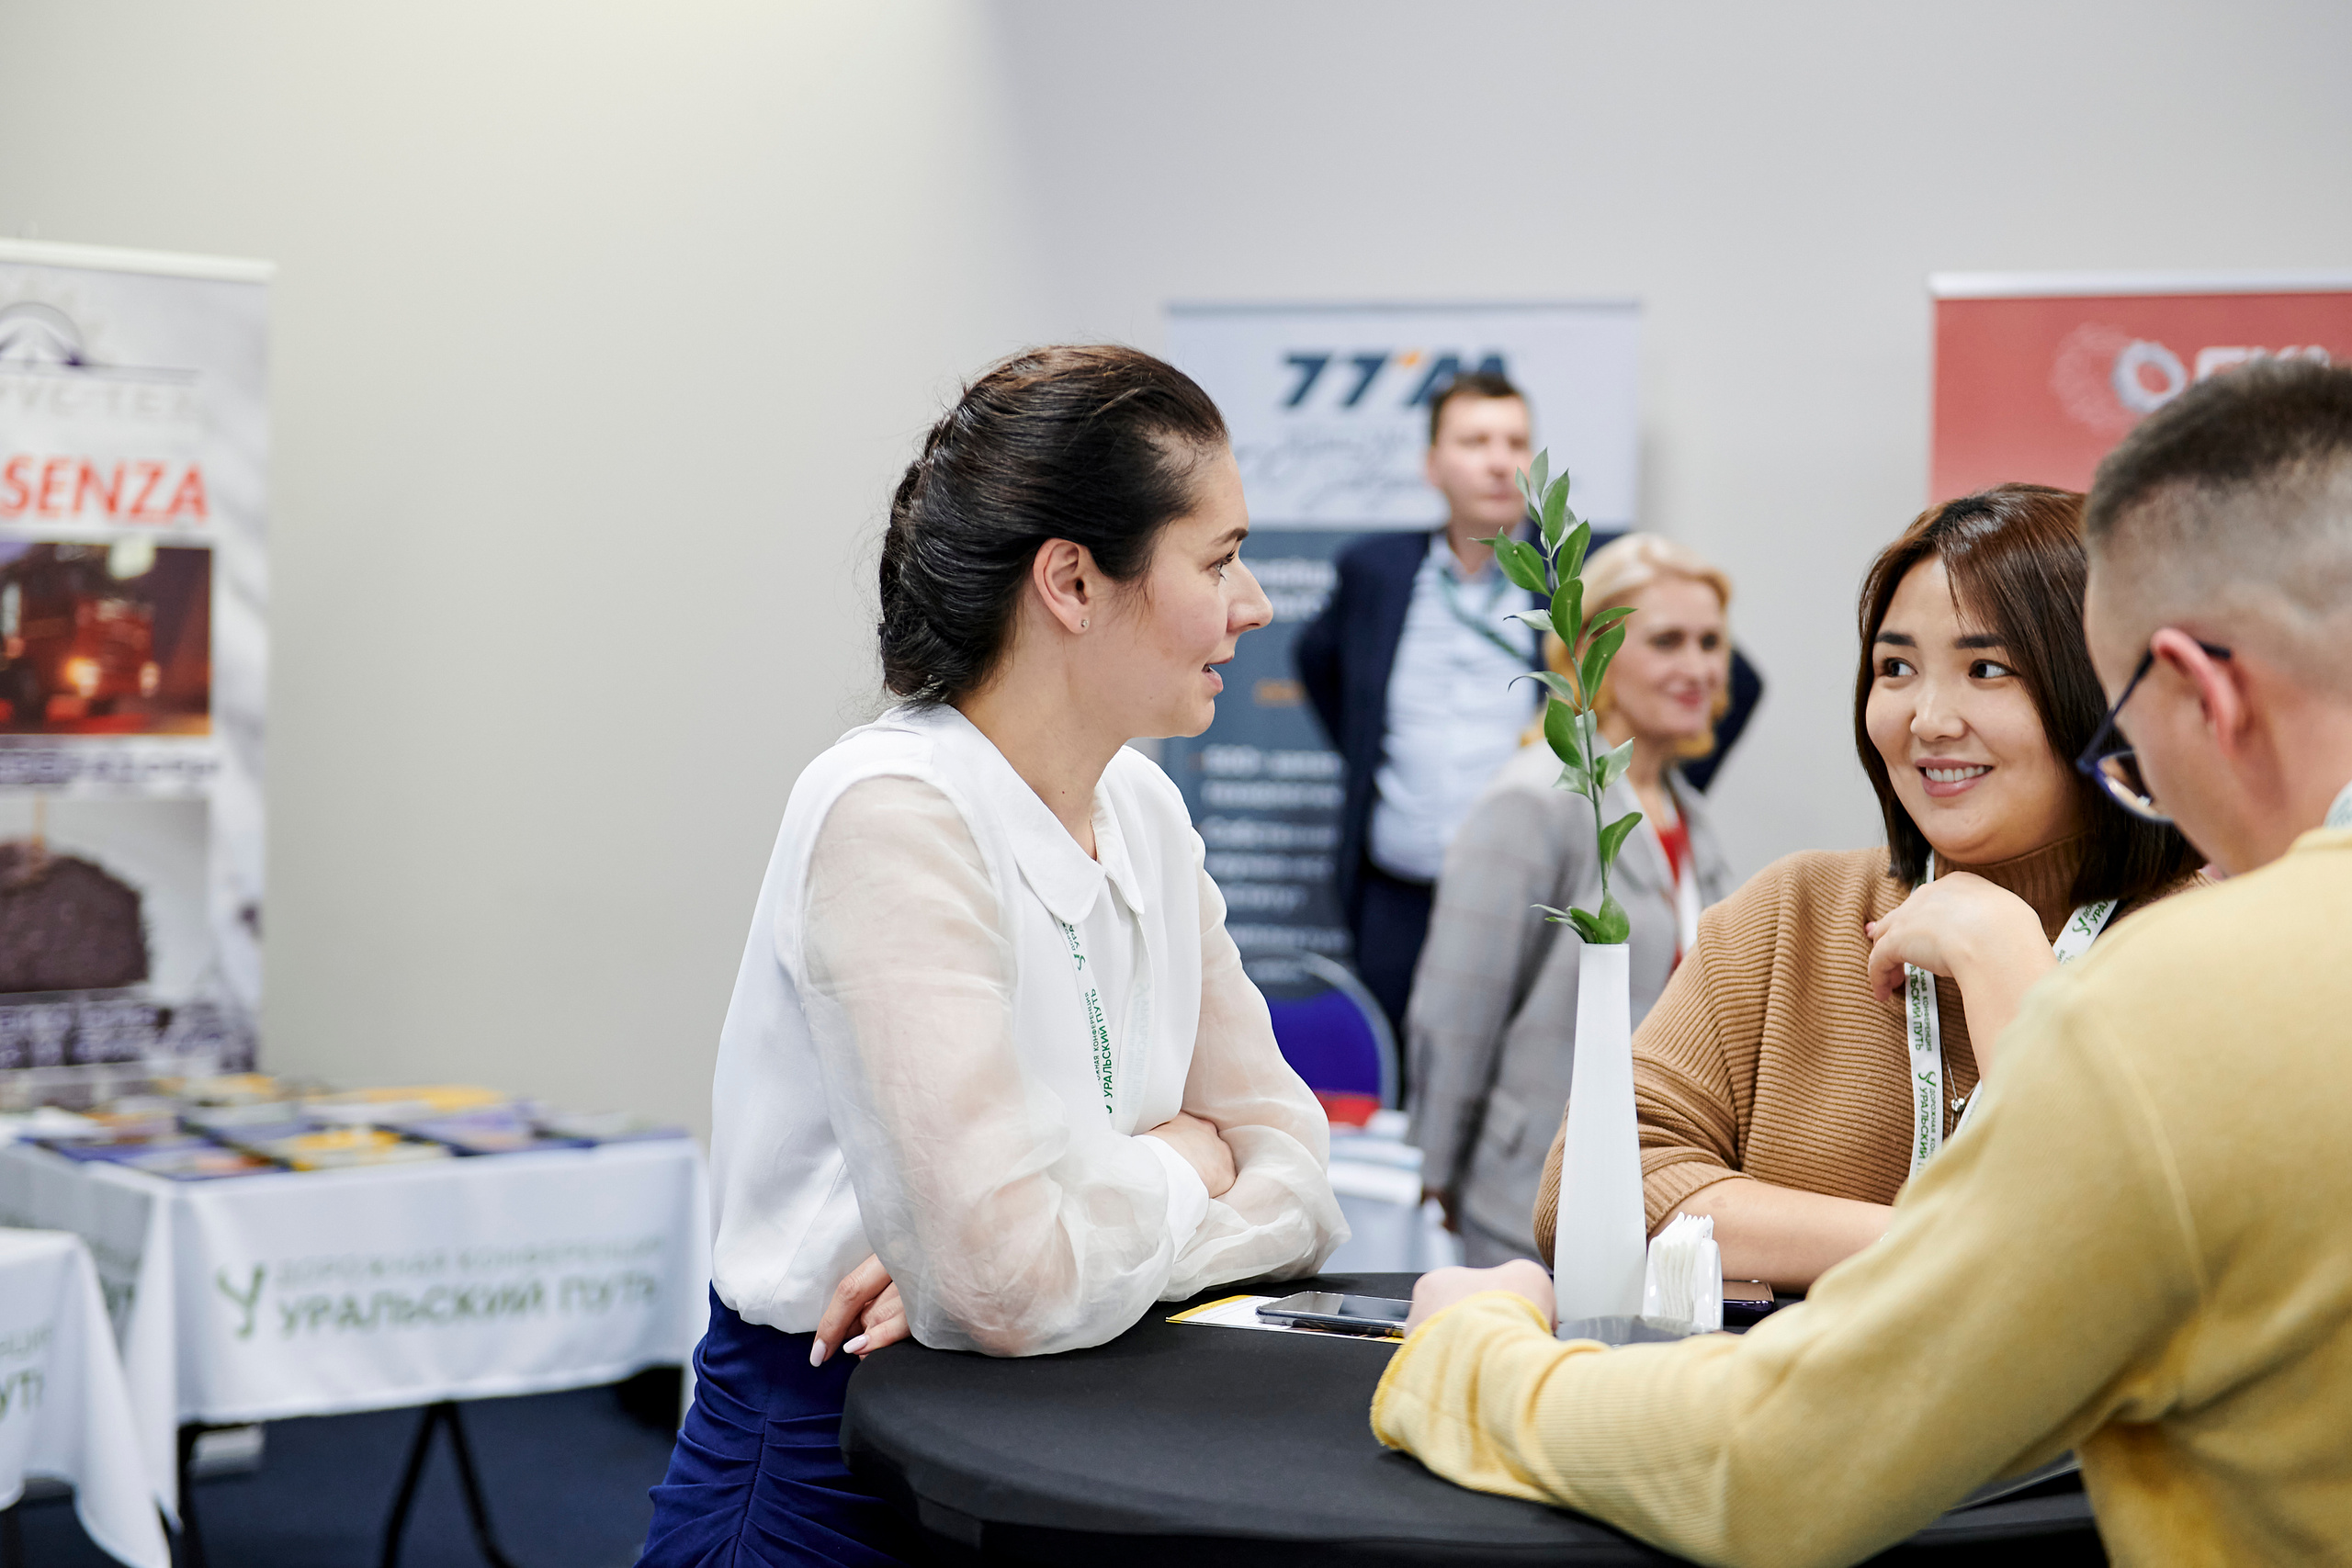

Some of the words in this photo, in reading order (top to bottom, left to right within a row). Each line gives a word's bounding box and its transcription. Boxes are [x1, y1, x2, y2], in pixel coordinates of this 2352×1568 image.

[0, 456, 209, 523] SENZA
[1085, 992, 1100, 1053] КОНФЕРЕНЦИЯ
[1091, 988, 1103, 1022] ПУТЬ
[1913, 1021, 1924, 1051] ПУТЬ
[1098, 1025, 1113, 1099] УРАЛЬСКИЙ
[1918, 1087, 1929, 1159] УРАЛЬСКИЙ
[277, 1275, 545, 1339] УРАЛЬСКИЙ
